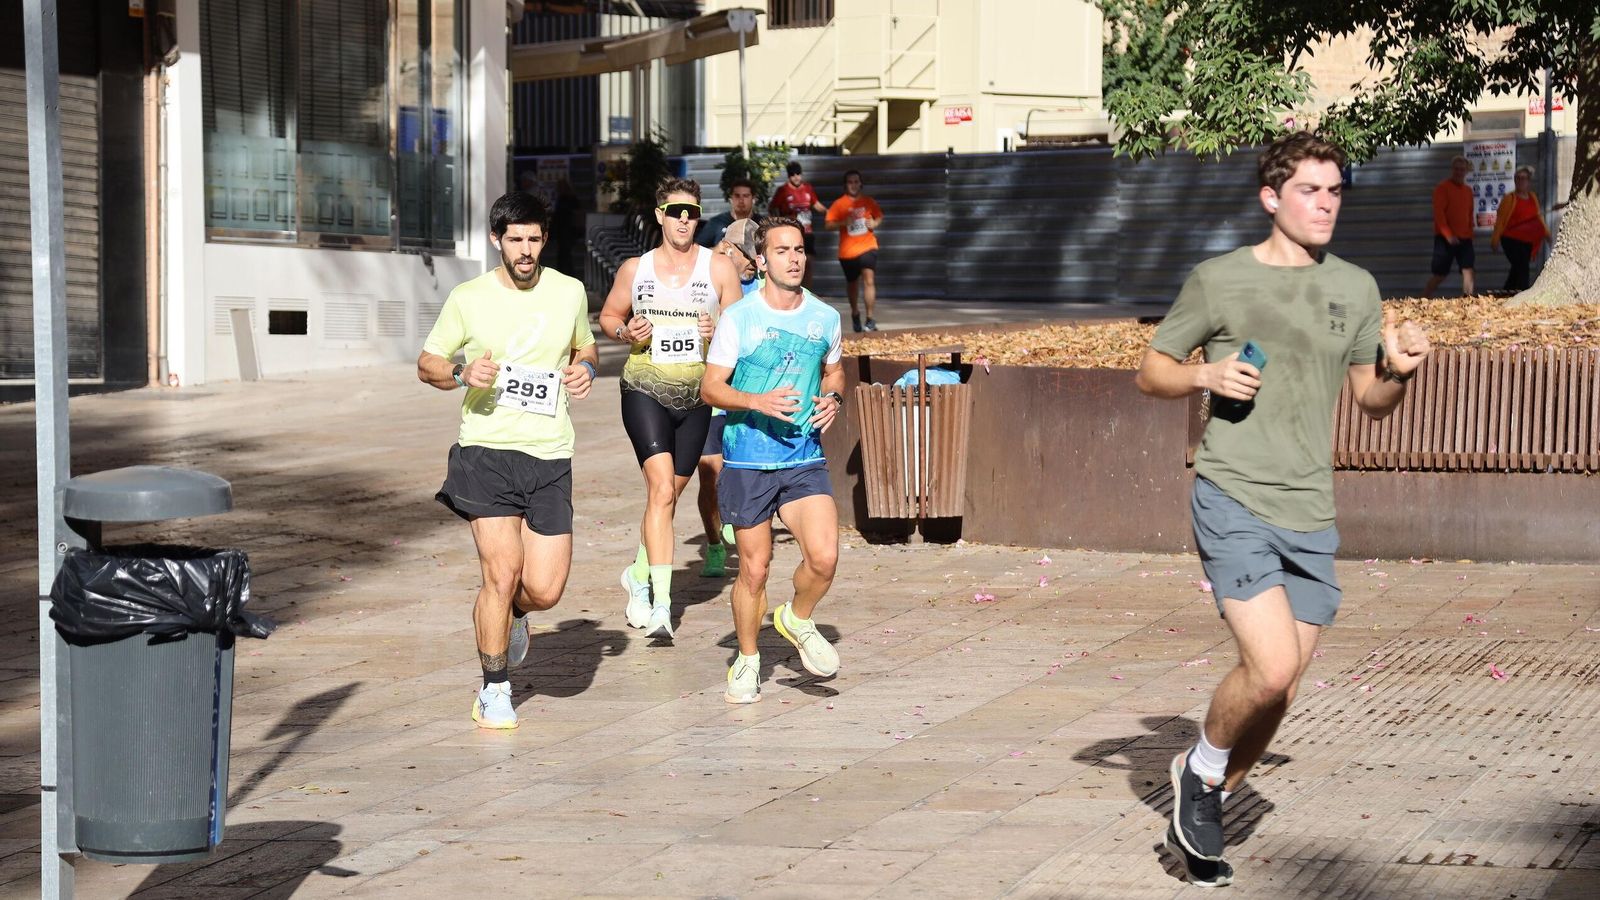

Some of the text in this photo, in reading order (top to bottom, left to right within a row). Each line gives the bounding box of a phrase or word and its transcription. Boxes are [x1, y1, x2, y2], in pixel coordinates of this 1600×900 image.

[648, 308, 684, 317] TRIATLÓN
[660, 339, 694, 352] 505
[506, 378, 548, 399] 293
